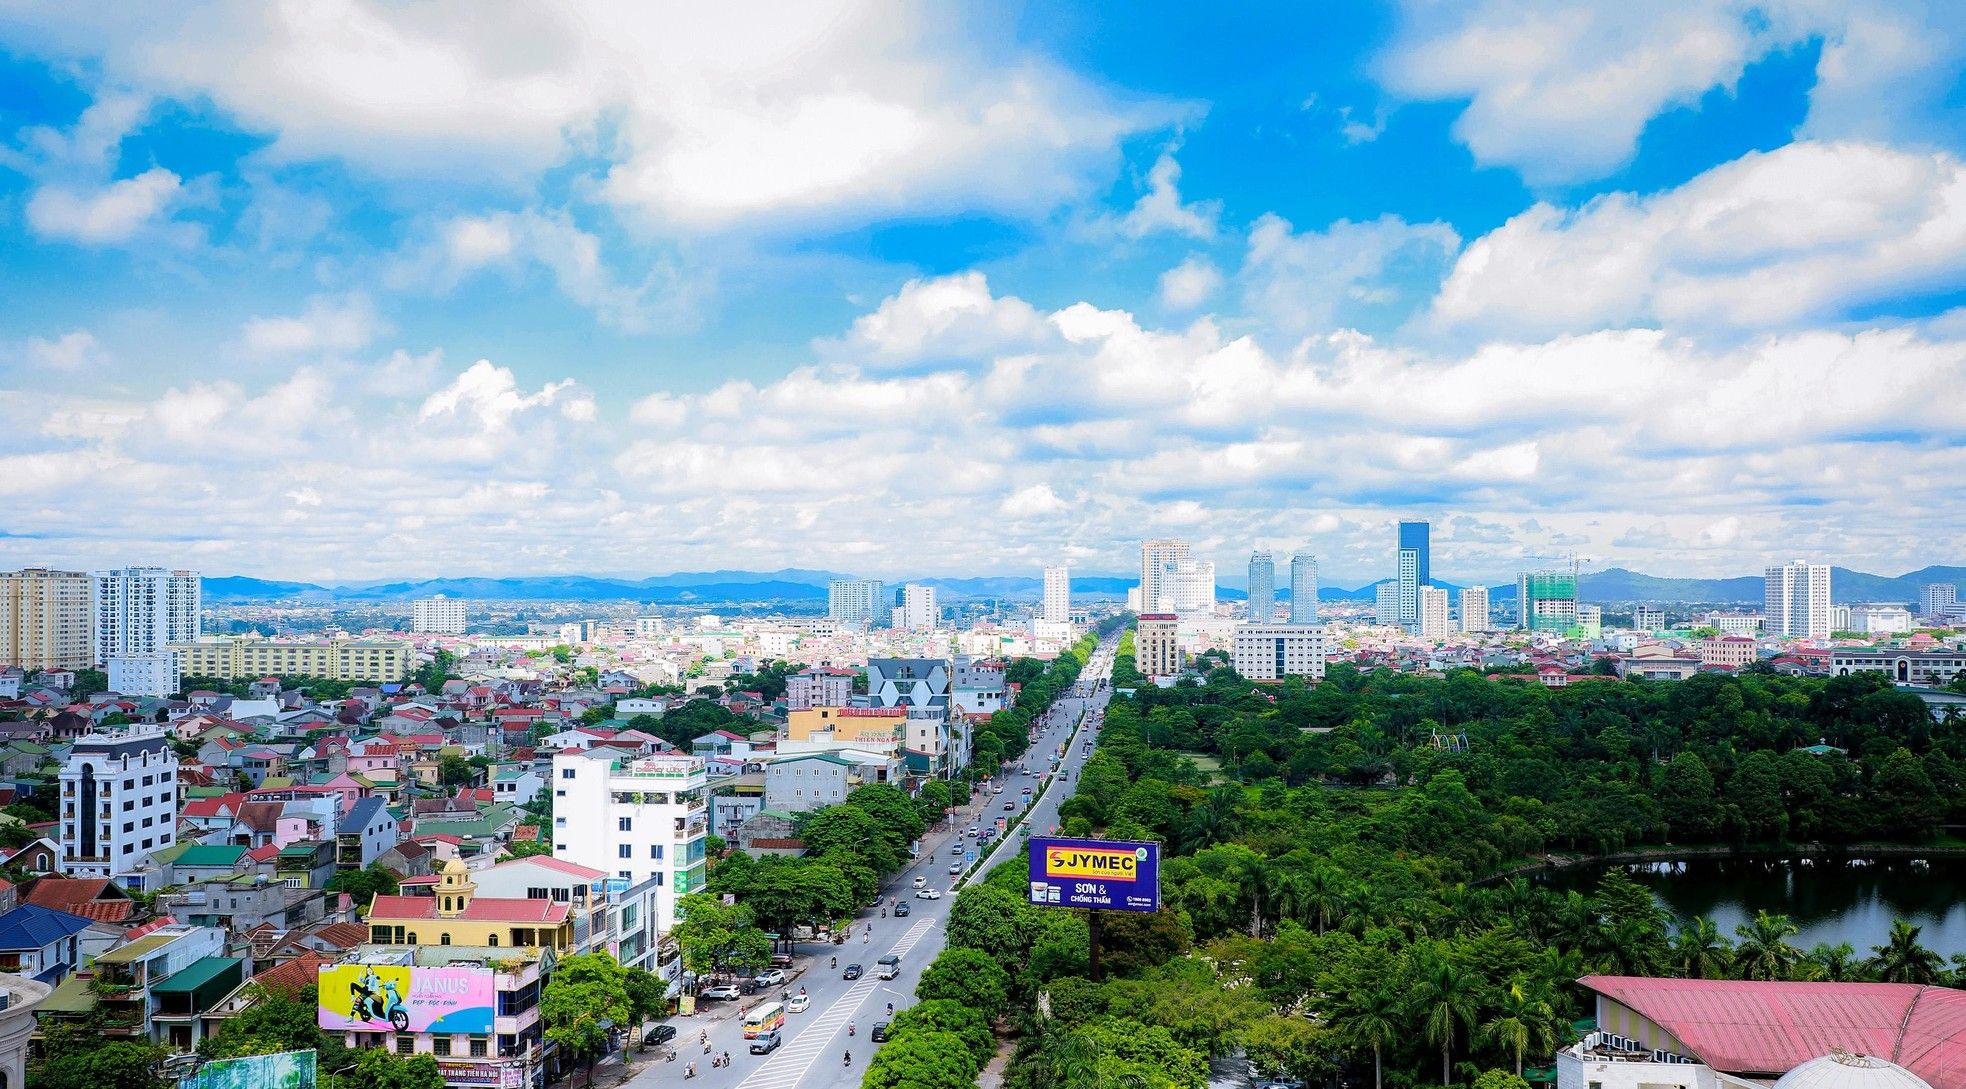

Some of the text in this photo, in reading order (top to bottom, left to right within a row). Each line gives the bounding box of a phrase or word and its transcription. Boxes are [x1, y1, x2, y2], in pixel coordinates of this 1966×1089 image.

[1067, 854, 1134, 870] JYMEC
[1076, 882, 1106, 894] SƠN &
[1070, 894, 1111, 904] CHỐNG THẤM
[414, 976, 468, 994] JANUS
